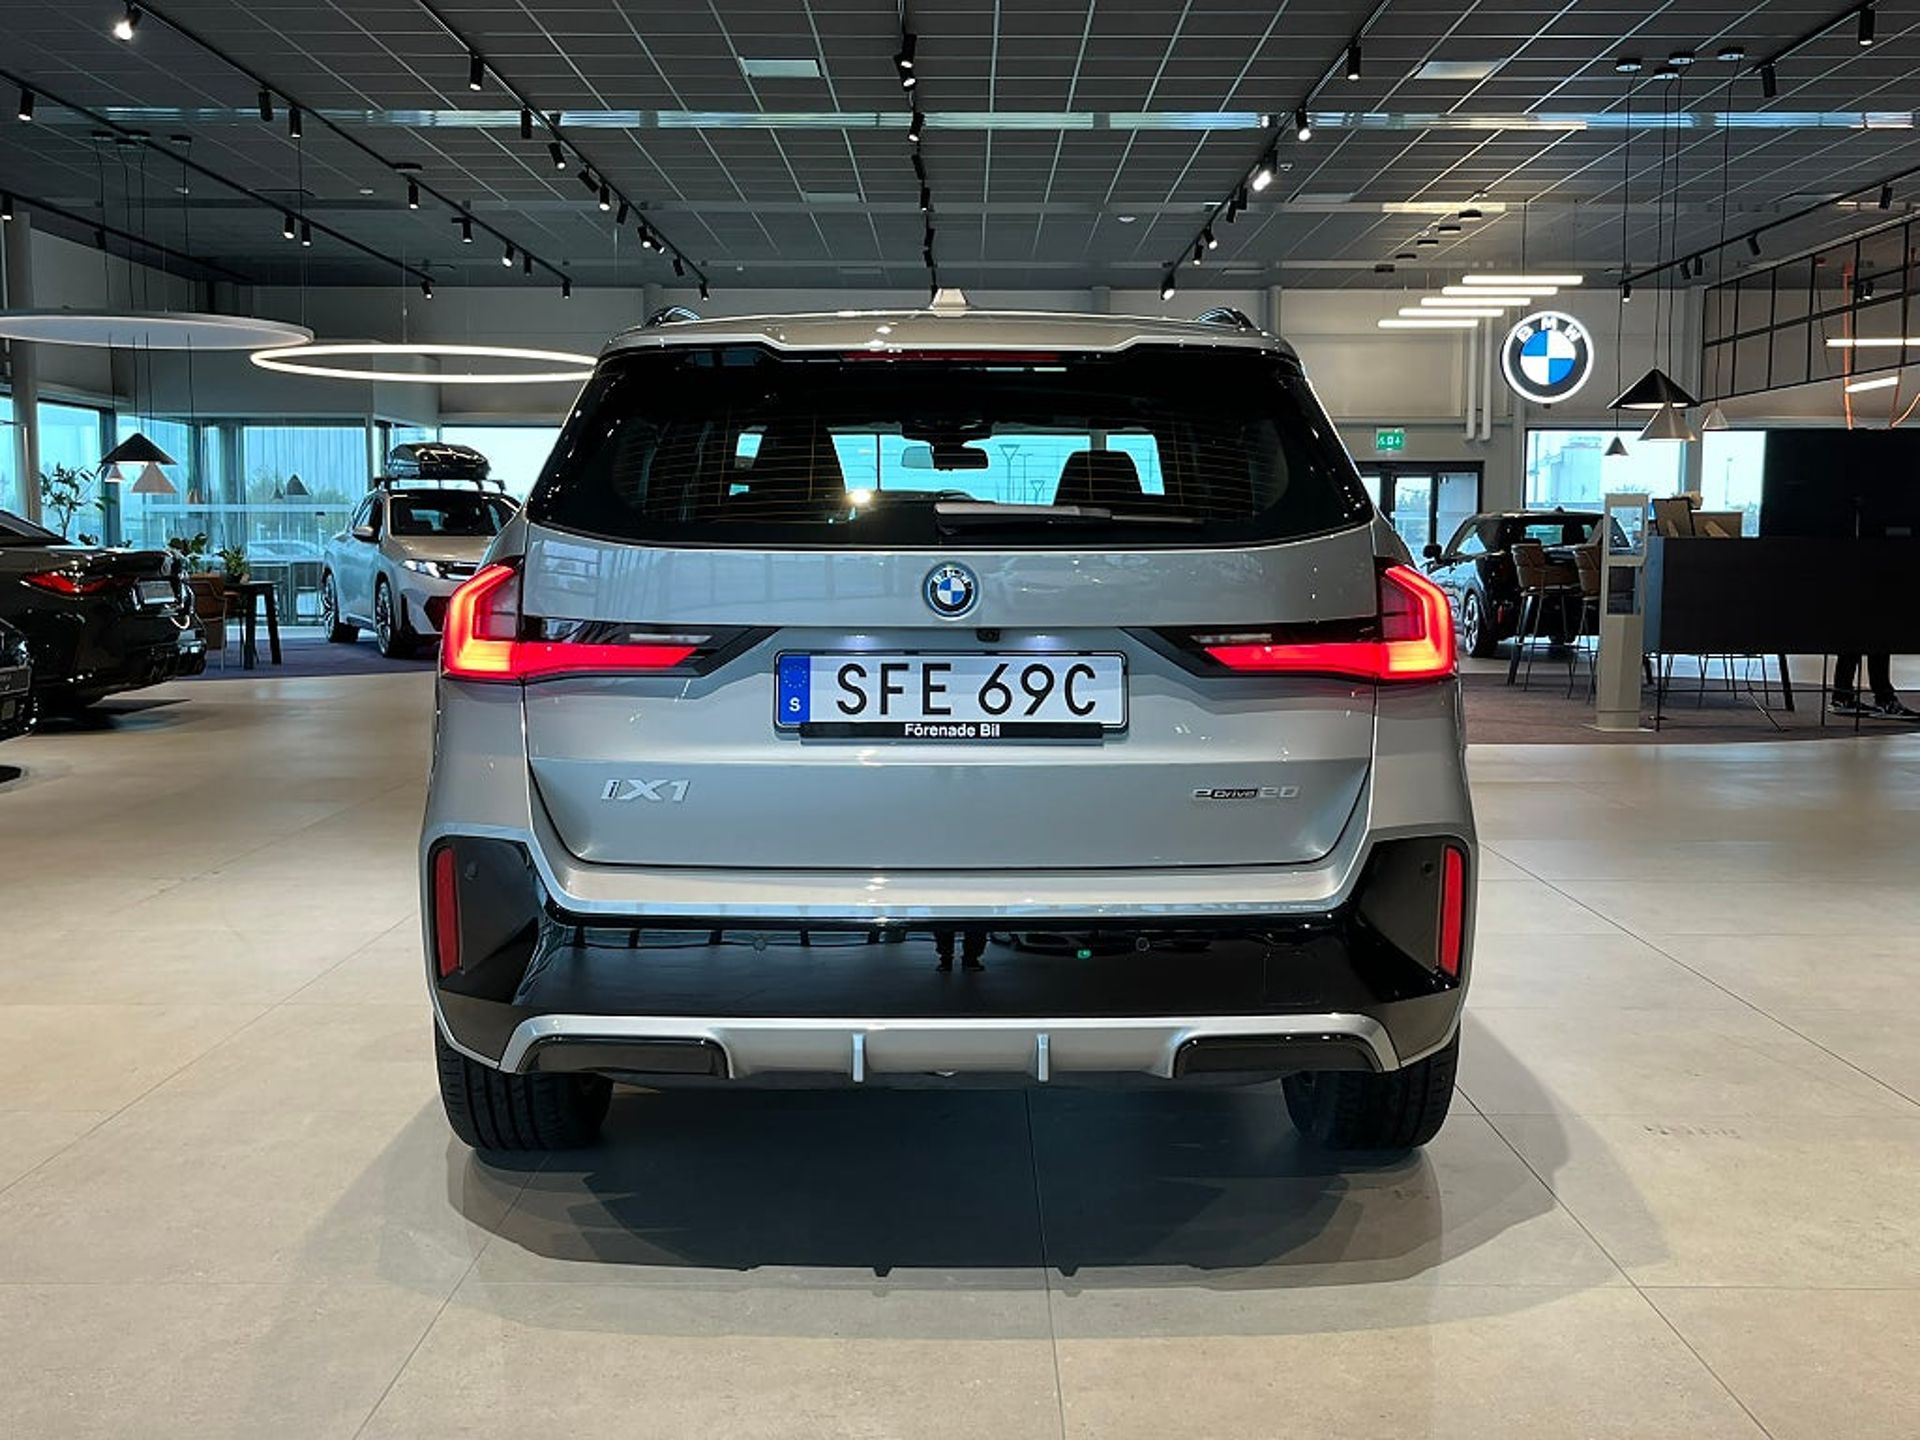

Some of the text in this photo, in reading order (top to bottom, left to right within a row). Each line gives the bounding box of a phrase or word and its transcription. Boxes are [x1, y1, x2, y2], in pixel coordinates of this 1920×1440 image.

[1515, 315, 1582, 343] BMW
[836, 663, 1097, 717] SFE 69C
[788, 697, 801, 712] S
[904, 723, 1001, 737] Förenade Bil
[600, 779, 691, 801] iX1
